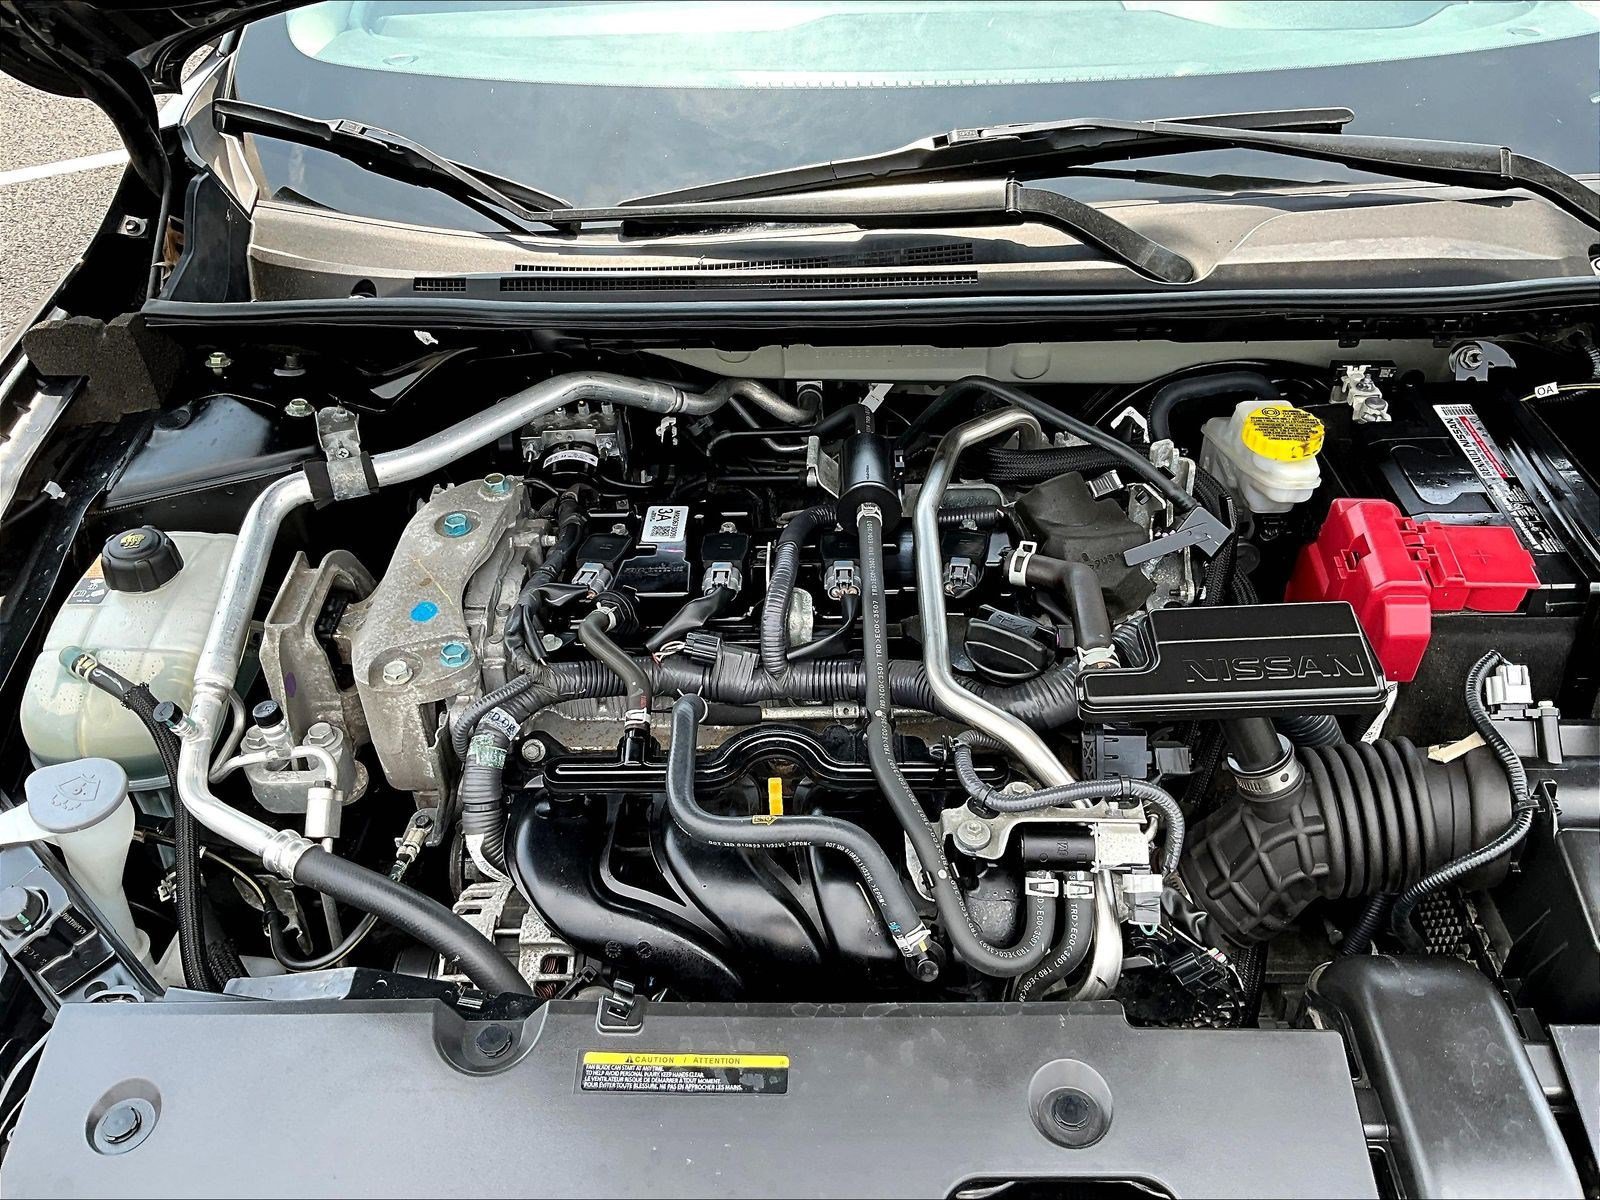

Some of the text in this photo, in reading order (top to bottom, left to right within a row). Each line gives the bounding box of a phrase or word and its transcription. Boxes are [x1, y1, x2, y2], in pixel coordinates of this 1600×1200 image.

[1537, 385, 1554, 396] OA
[1446, 418, 1471, 448] NISSAN
[1466, 448, 1491, 477] RENAULT
[656, 508, 673, 521] 3A
[1183, 654, 1364, 682] NISSAN
[634, 1056, 674, 1064] CAUTION
